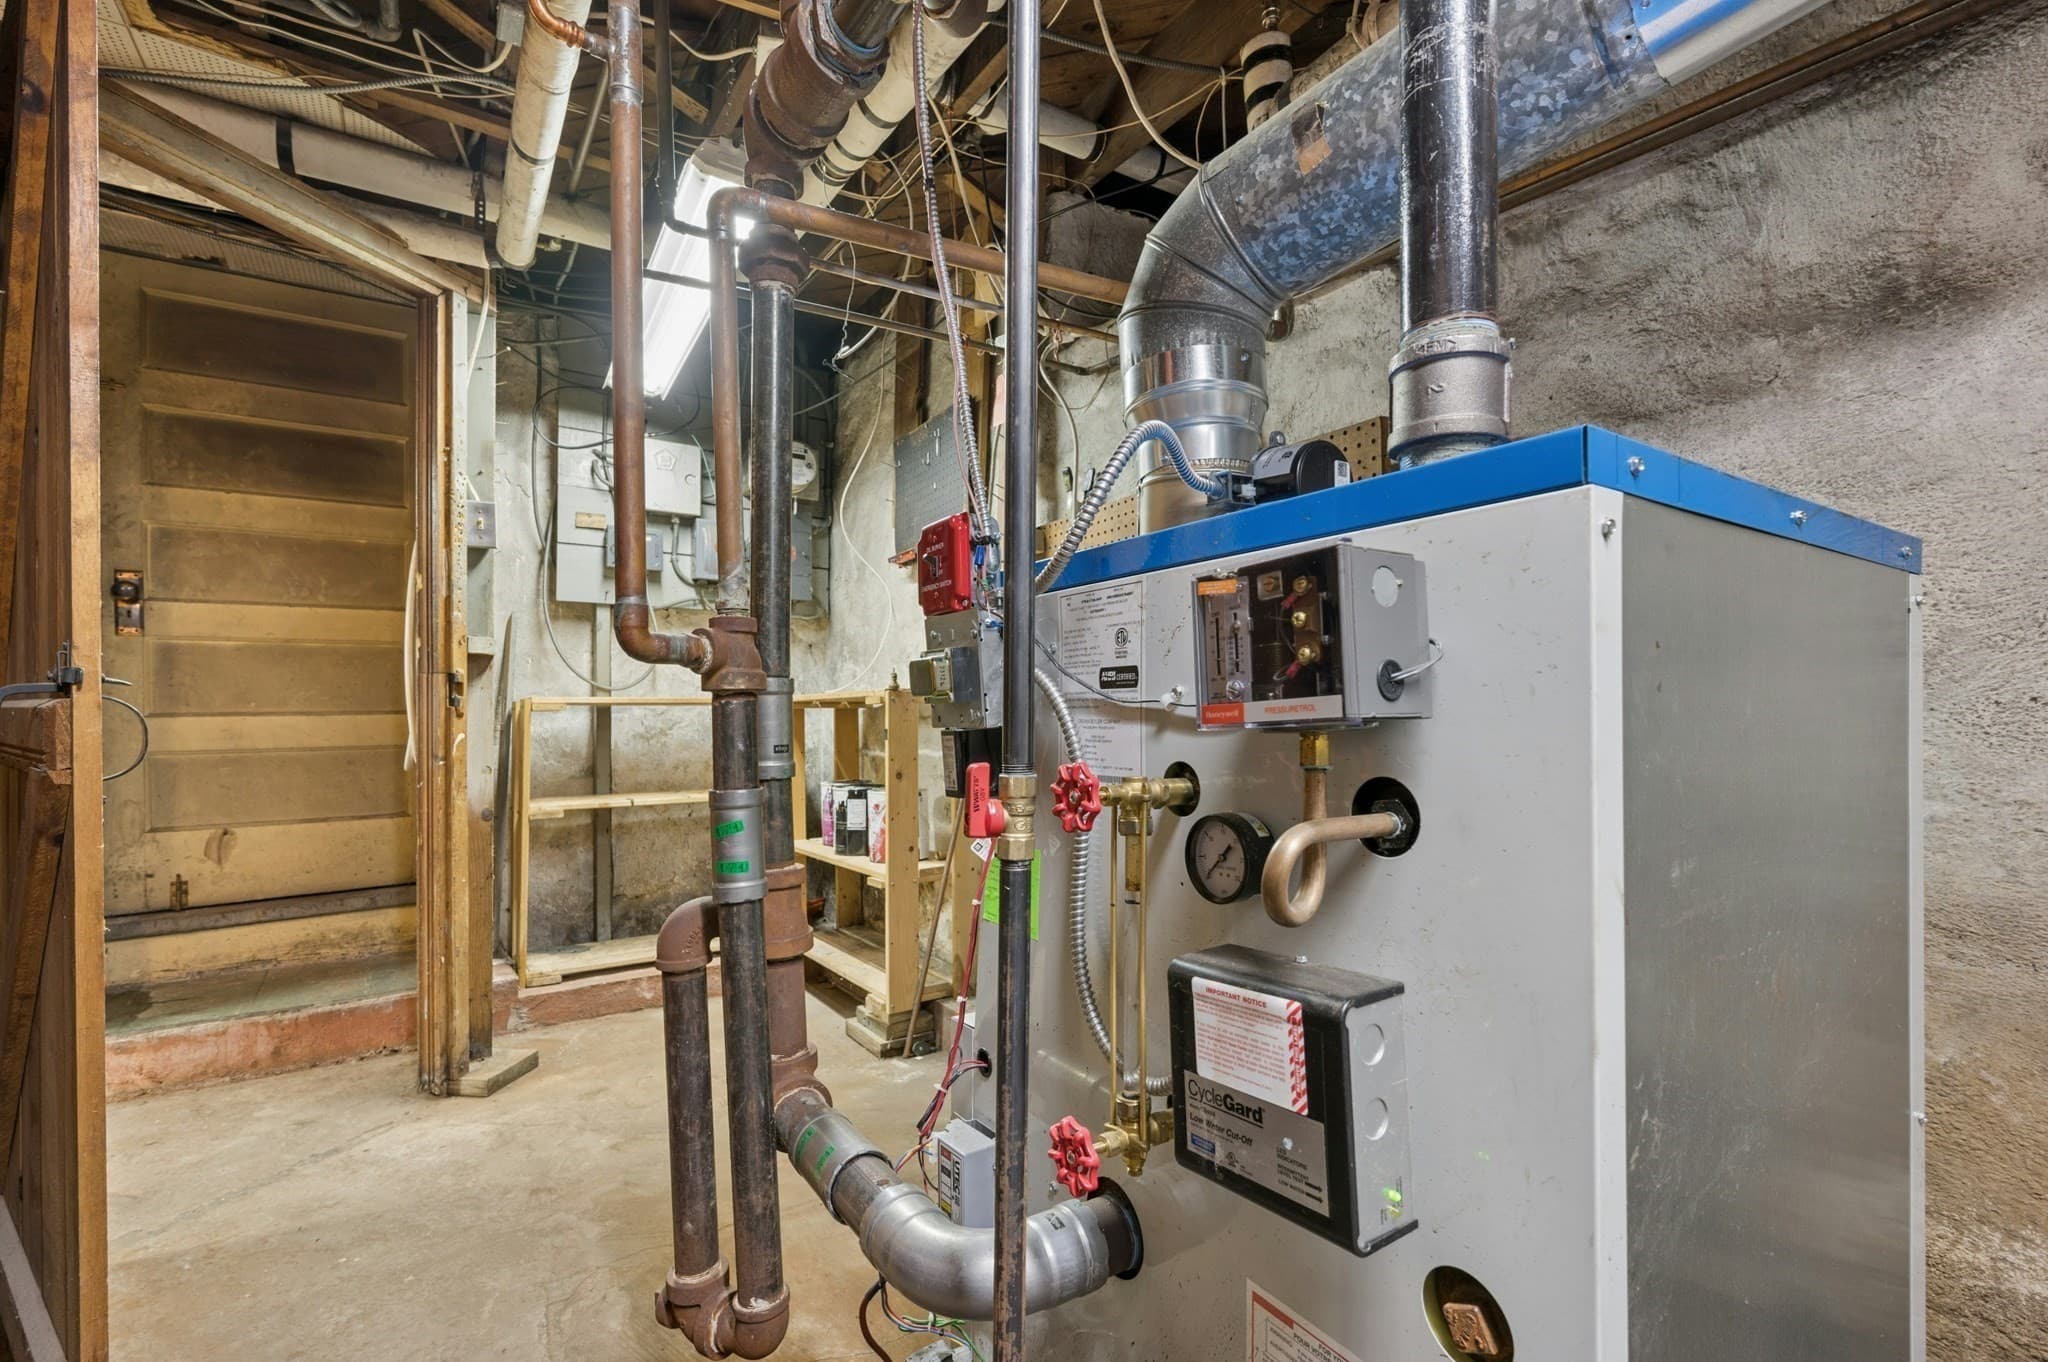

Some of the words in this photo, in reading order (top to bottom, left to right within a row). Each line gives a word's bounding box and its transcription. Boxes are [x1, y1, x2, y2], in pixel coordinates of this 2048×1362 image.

[1205, 709, 1239, 719] Honeywell
[1264, 704, 1316, 714] PRESSURETROL
[1205, 987, 1240, 1001] IMPORTANT
[1243, 997, 1267, 1008] NOTICE
[1188, 1079, 1264, 1124] CycleGard
[1189, 1112, 1204, 1124] Low
[1205, 1116, 1225, 1133] Water
[1225, 1127, 1253, 1146] Cut-Off
